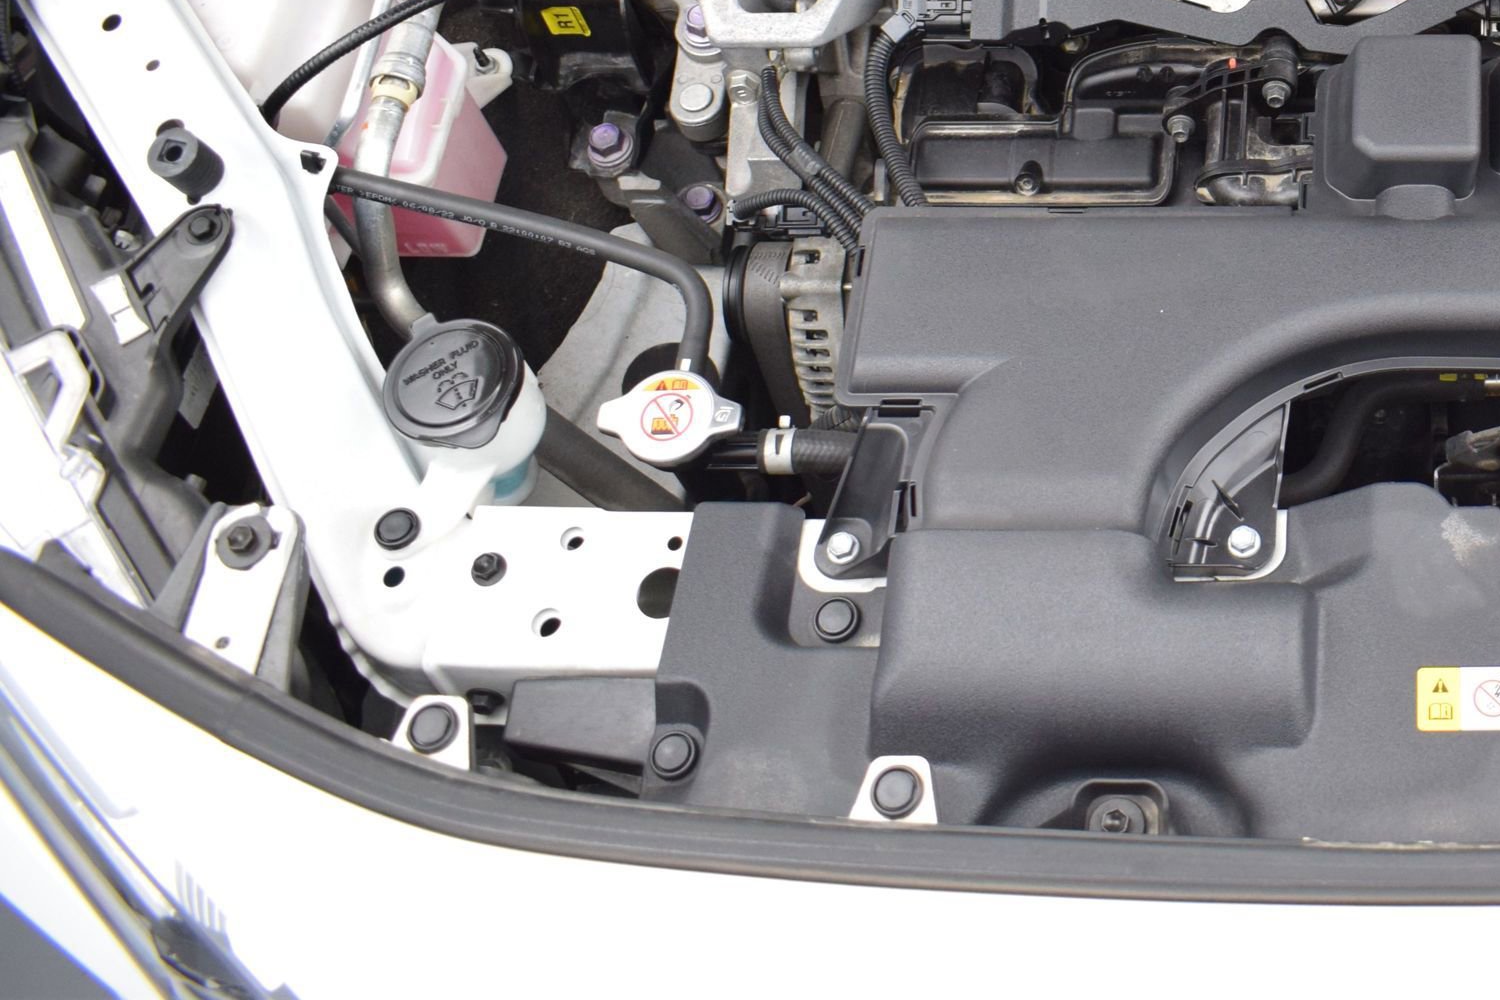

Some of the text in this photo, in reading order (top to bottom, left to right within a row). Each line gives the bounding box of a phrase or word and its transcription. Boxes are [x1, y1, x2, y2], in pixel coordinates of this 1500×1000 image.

[551, 13, 575, 28] R1
[402, 340, 480, 386] WASHER FLUID
[431, 360, 459, 381] ONLY
